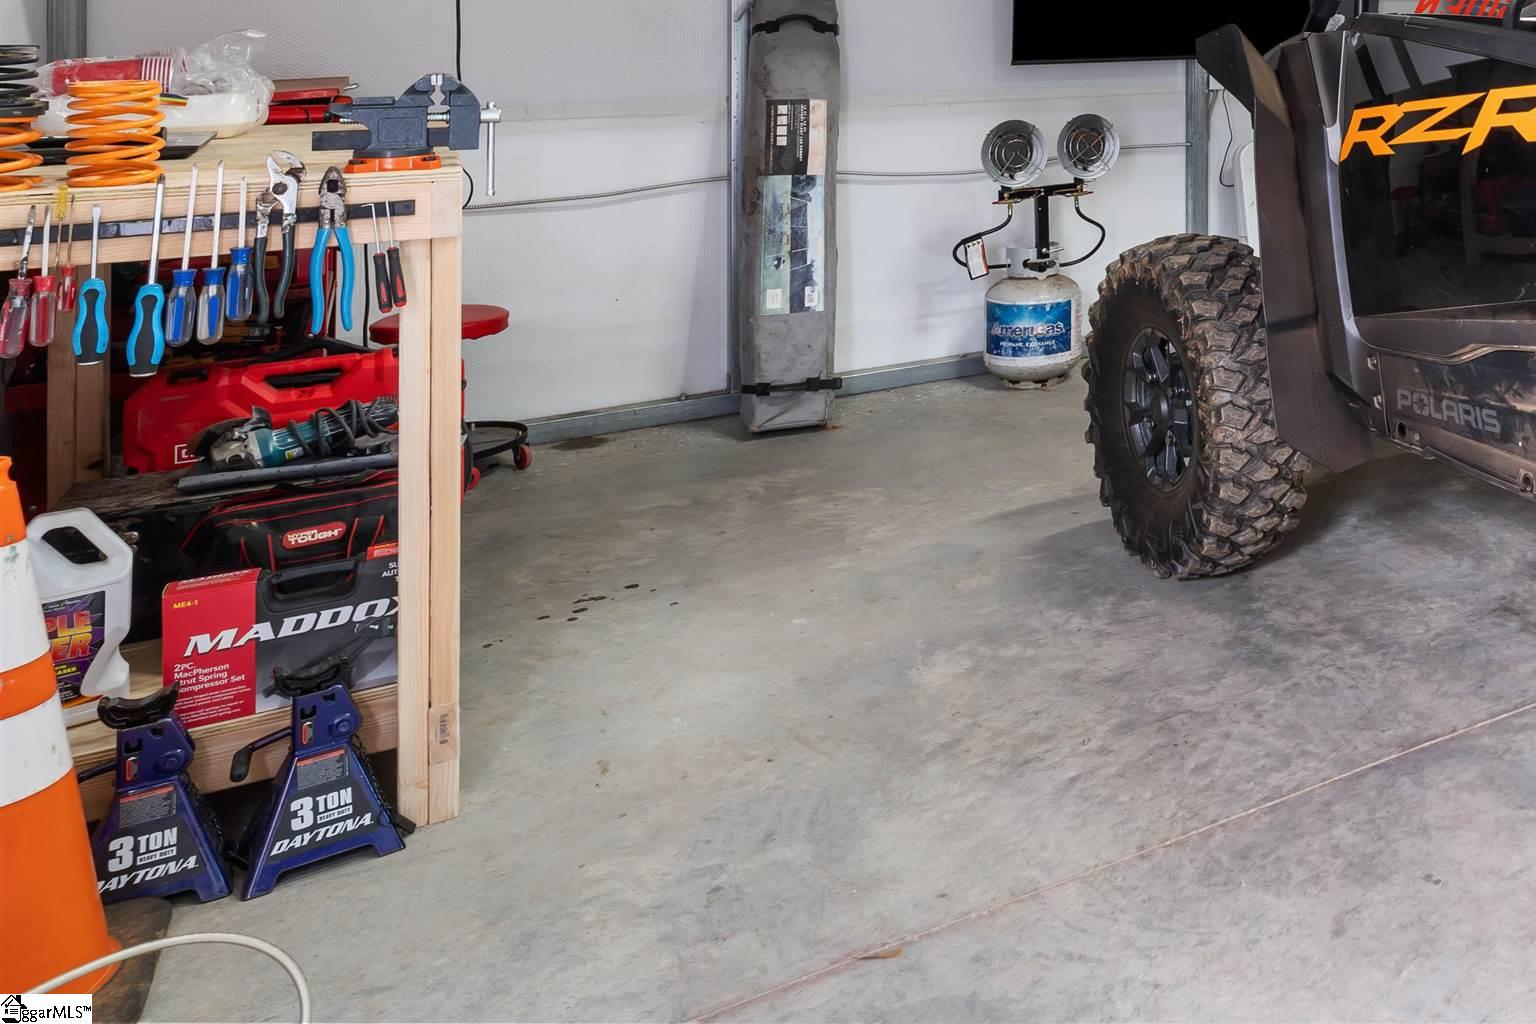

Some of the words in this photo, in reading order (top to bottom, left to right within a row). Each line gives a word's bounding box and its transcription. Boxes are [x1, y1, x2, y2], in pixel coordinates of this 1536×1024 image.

[1396, 388, 1500, 433] POLARIS
[288, 529, 340, 545] TOUGH
[174, 663, 230, 680] MacPherson
[198, 672, 228, 684] Spring
[230, 674, 246, 683] Set
[316, 787, 352, 812] TON
[290, 796, 314, 831] 3
[319, 812, 336, 820] HEAVY
[337, 807, 351, 816] DUTY
[137, 827, 178, 853] TON
[270, 812, 373, 856] DAYTONA
[108, 835, 134, 872] 3
[138, 853, 158, 863] HEAVY
[159, 849, 174, 857] DUTY
